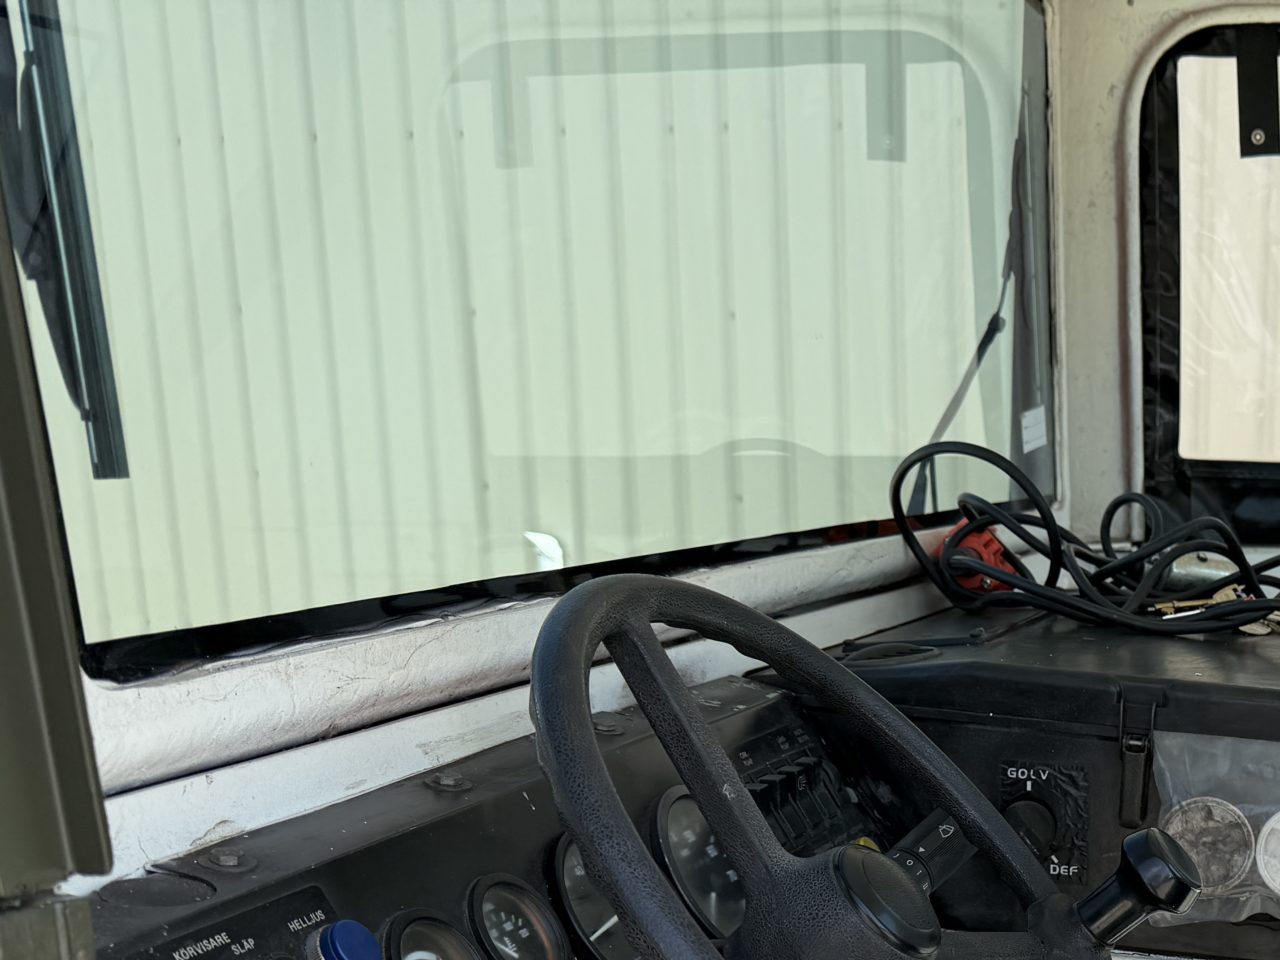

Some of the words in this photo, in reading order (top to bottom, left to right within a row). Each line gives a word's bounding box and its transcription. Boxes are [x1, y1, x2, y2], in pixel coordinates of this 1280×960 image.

[1006, 767, 1049, 780] GOLV
[1049, 864, 1078, 876] DEF
[287, 910, 325, 932] HELLJUS
[231, 938, 255, 956] SLÄP
